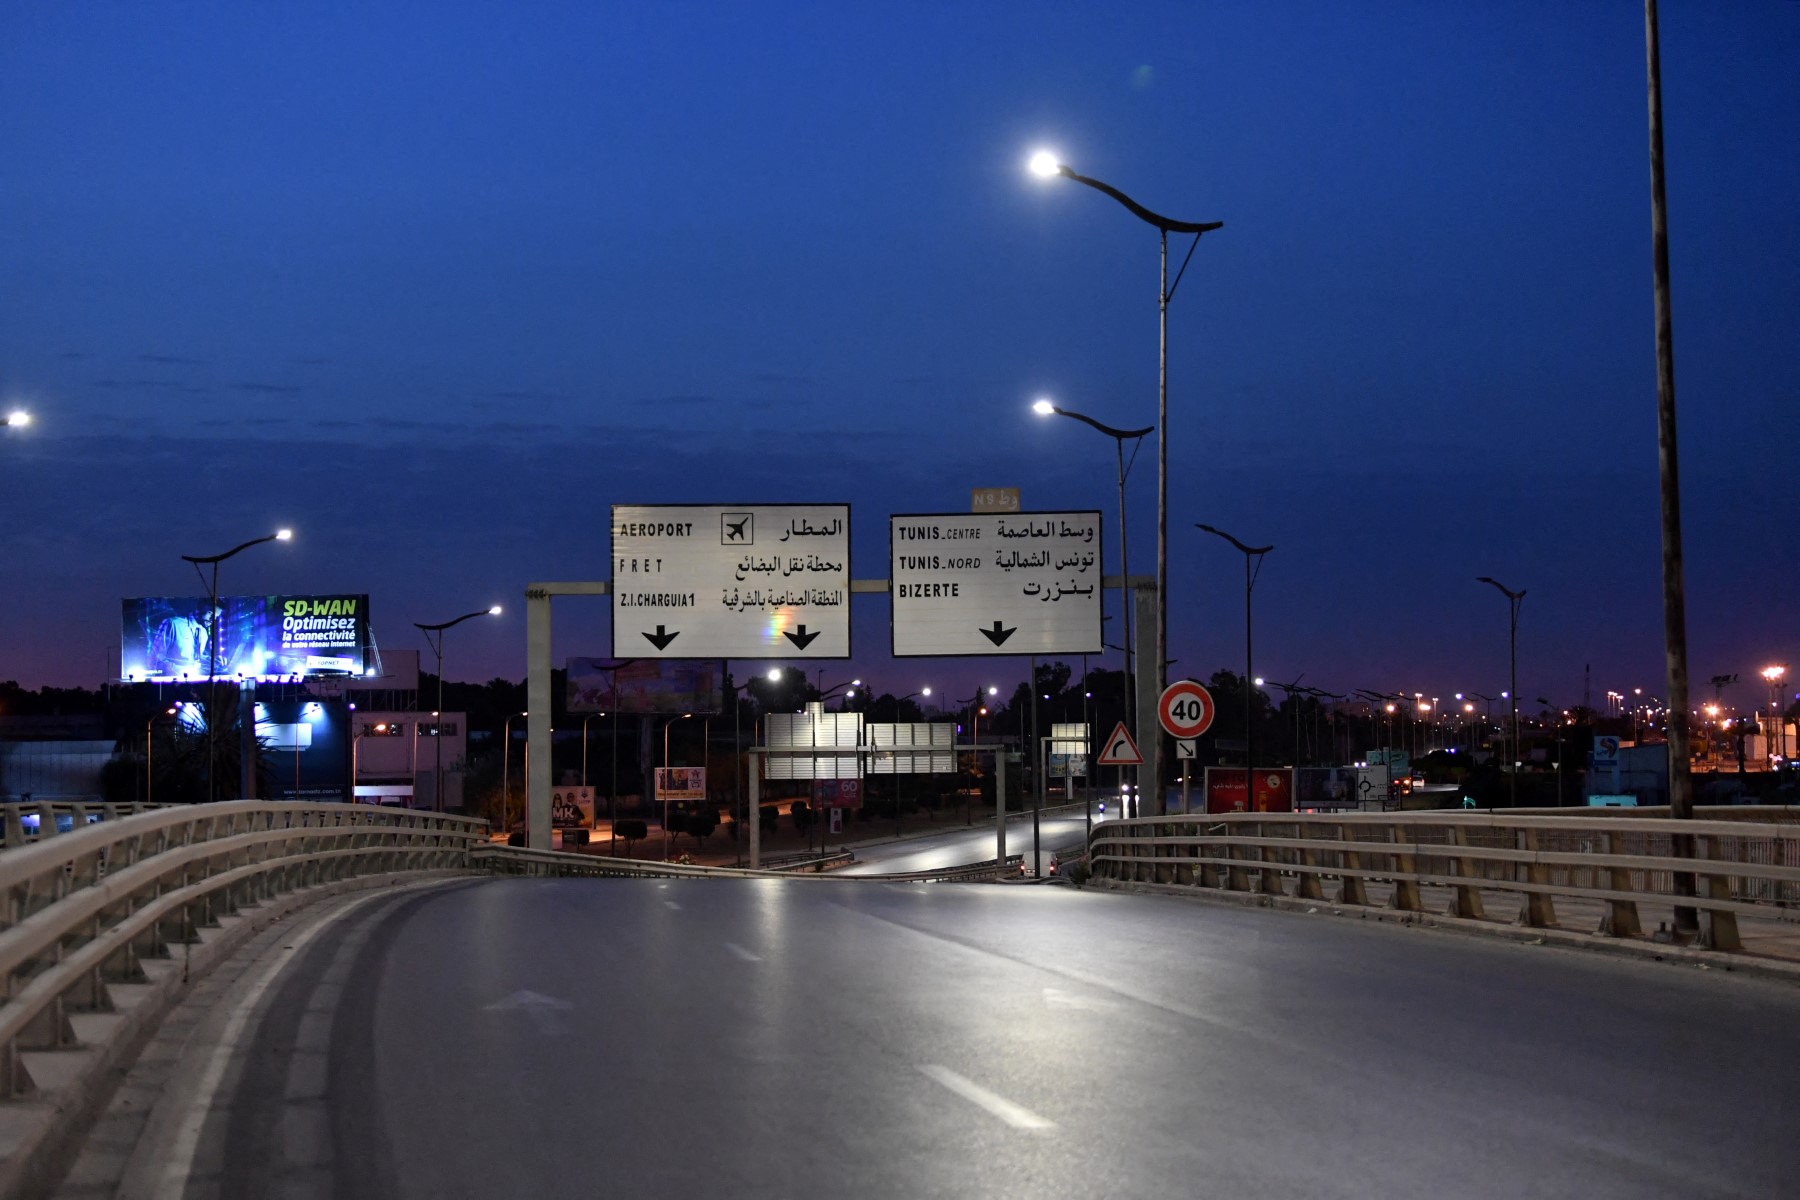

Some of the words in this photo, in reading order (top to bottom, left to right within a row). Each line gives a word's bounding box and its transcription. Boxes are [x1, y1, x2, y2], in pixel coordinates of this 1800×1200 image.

[620, 522, 693, 537] AEROPORT
[780, 518, 842, 542] المطار
[997, 520, 1056, 539] العاصمة
[1060, 520, 1094, 543] وسط
[619, 558, 662, 573] FRET
[735, 555, 781, 582] البضائع
[783, 557, 805, 577] نقل
[806, 554, 843, 573] محطة
[995, 549, 1050, 572] الشمالية
[1055, 551, 1094, 573] تونس
[767, 588, 811, 610] الصناعية
[811, 588, 843, 607] المنطقة
[899, 582, 959, 598] BIZERTE
[1022, 578, 1094, 602] بنزرت
[283, 600, 356, 617] SD-WAN
[283, 616, 356, 633] Optimisez
[282, 631, 292, 641] la
[294, 630, 356, 641] connectivité
[1172, 700, 1201, 721] 40
[841, 780, 857, 792] 60
